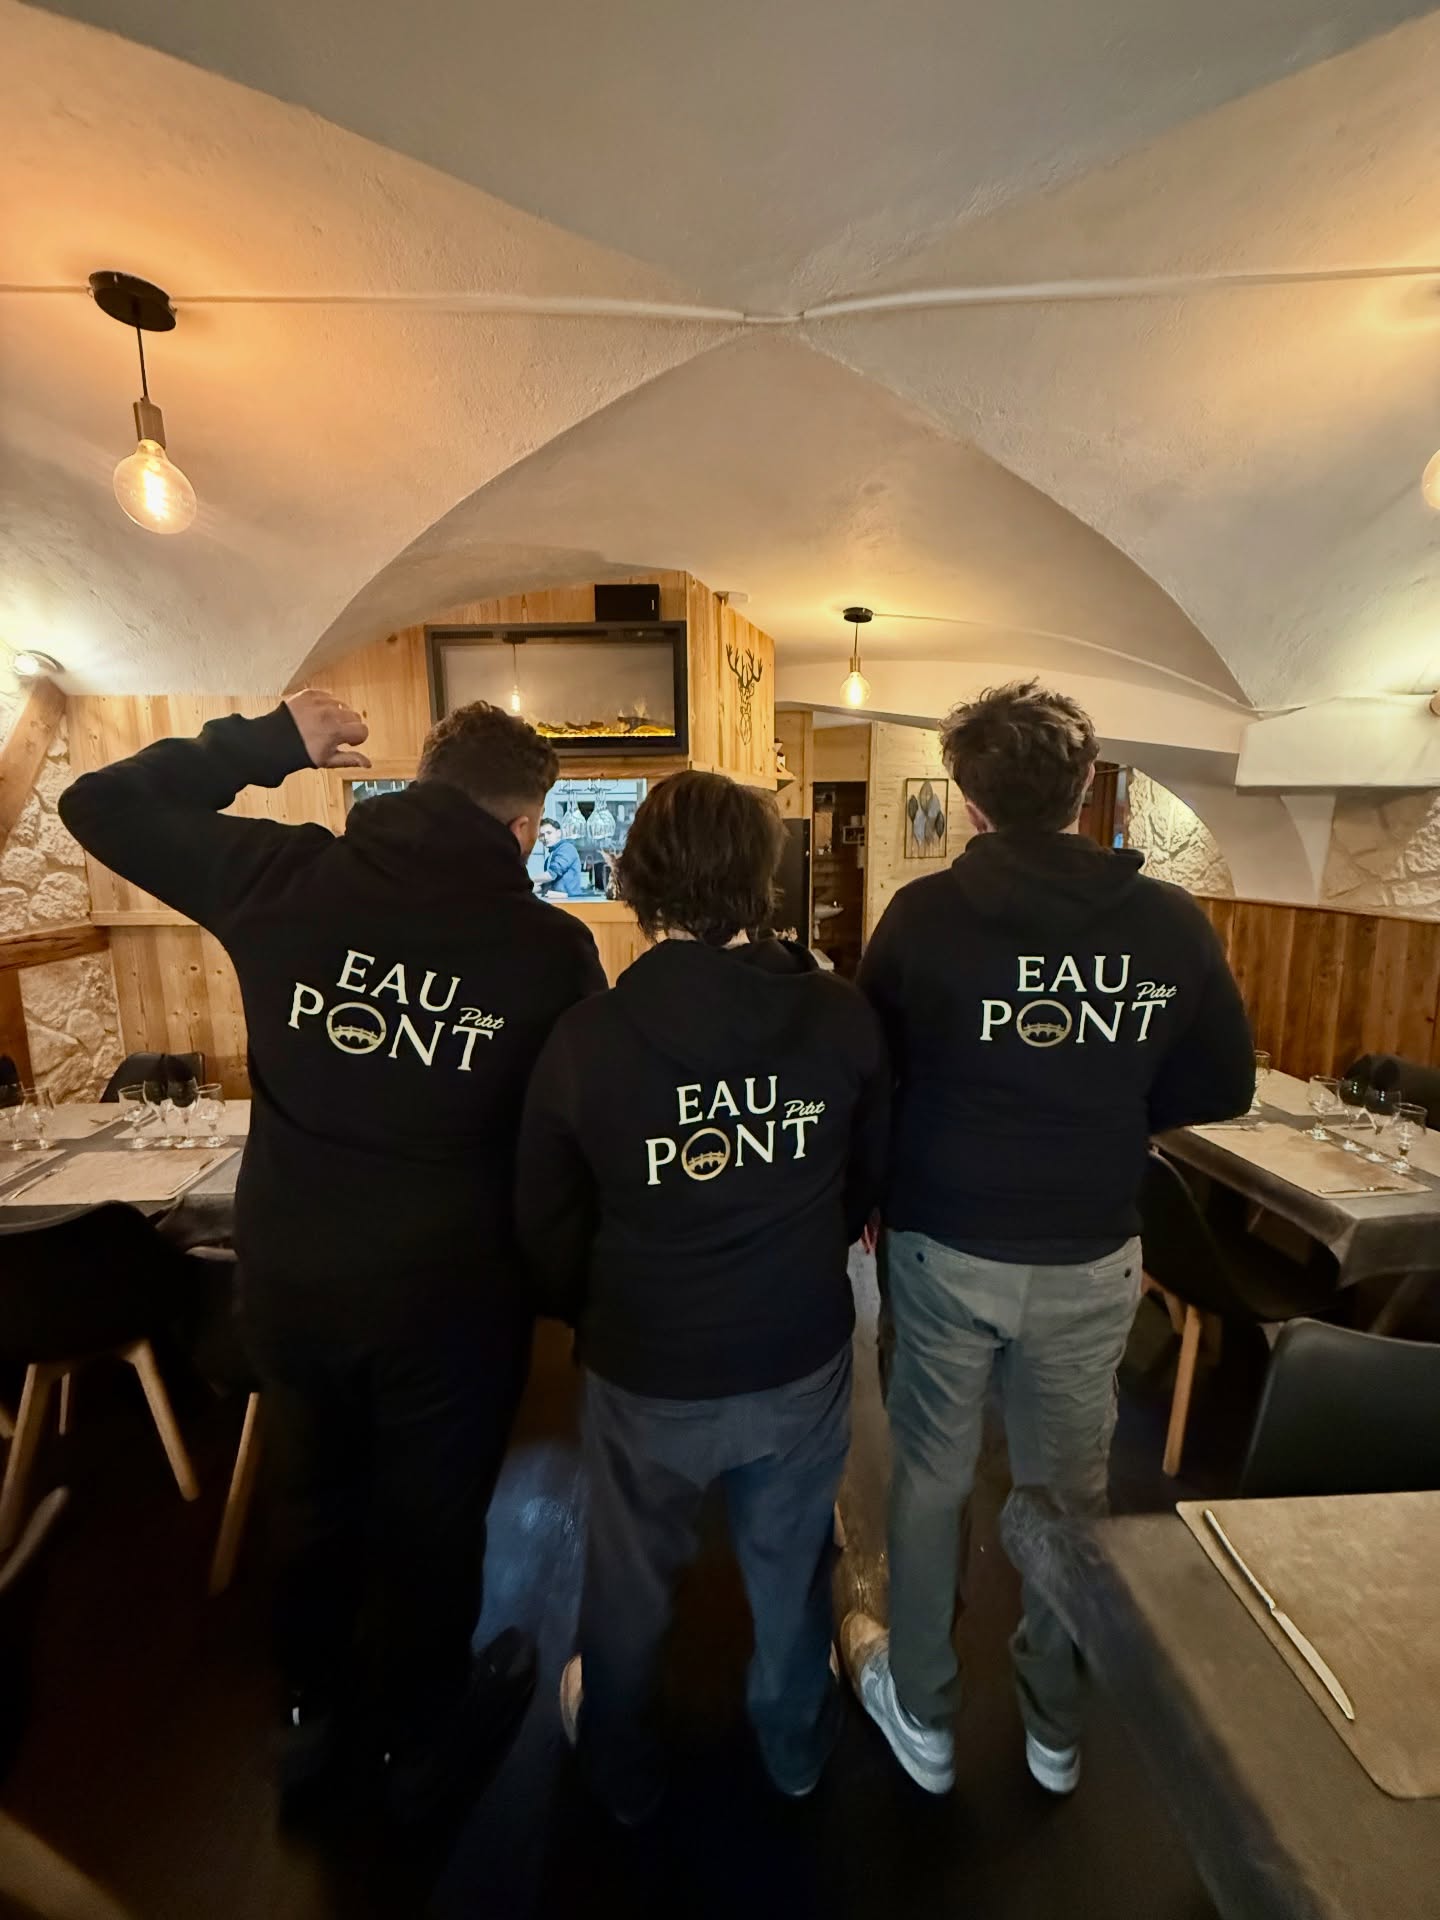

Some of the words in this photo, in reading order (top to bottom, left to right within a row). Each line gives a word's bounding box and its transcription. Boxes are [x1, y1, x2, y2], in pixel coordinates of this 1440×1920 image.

[336, 950, 461, 1012] EAU
[1017, 954, 1131, 993] EAU
[288, 982, 494, 1071] PONT
[979, 999, 1167, 1047] PONT
[676, 1075, 778, 1125] EAU
[645, 1115, 819, 1186] PONT
